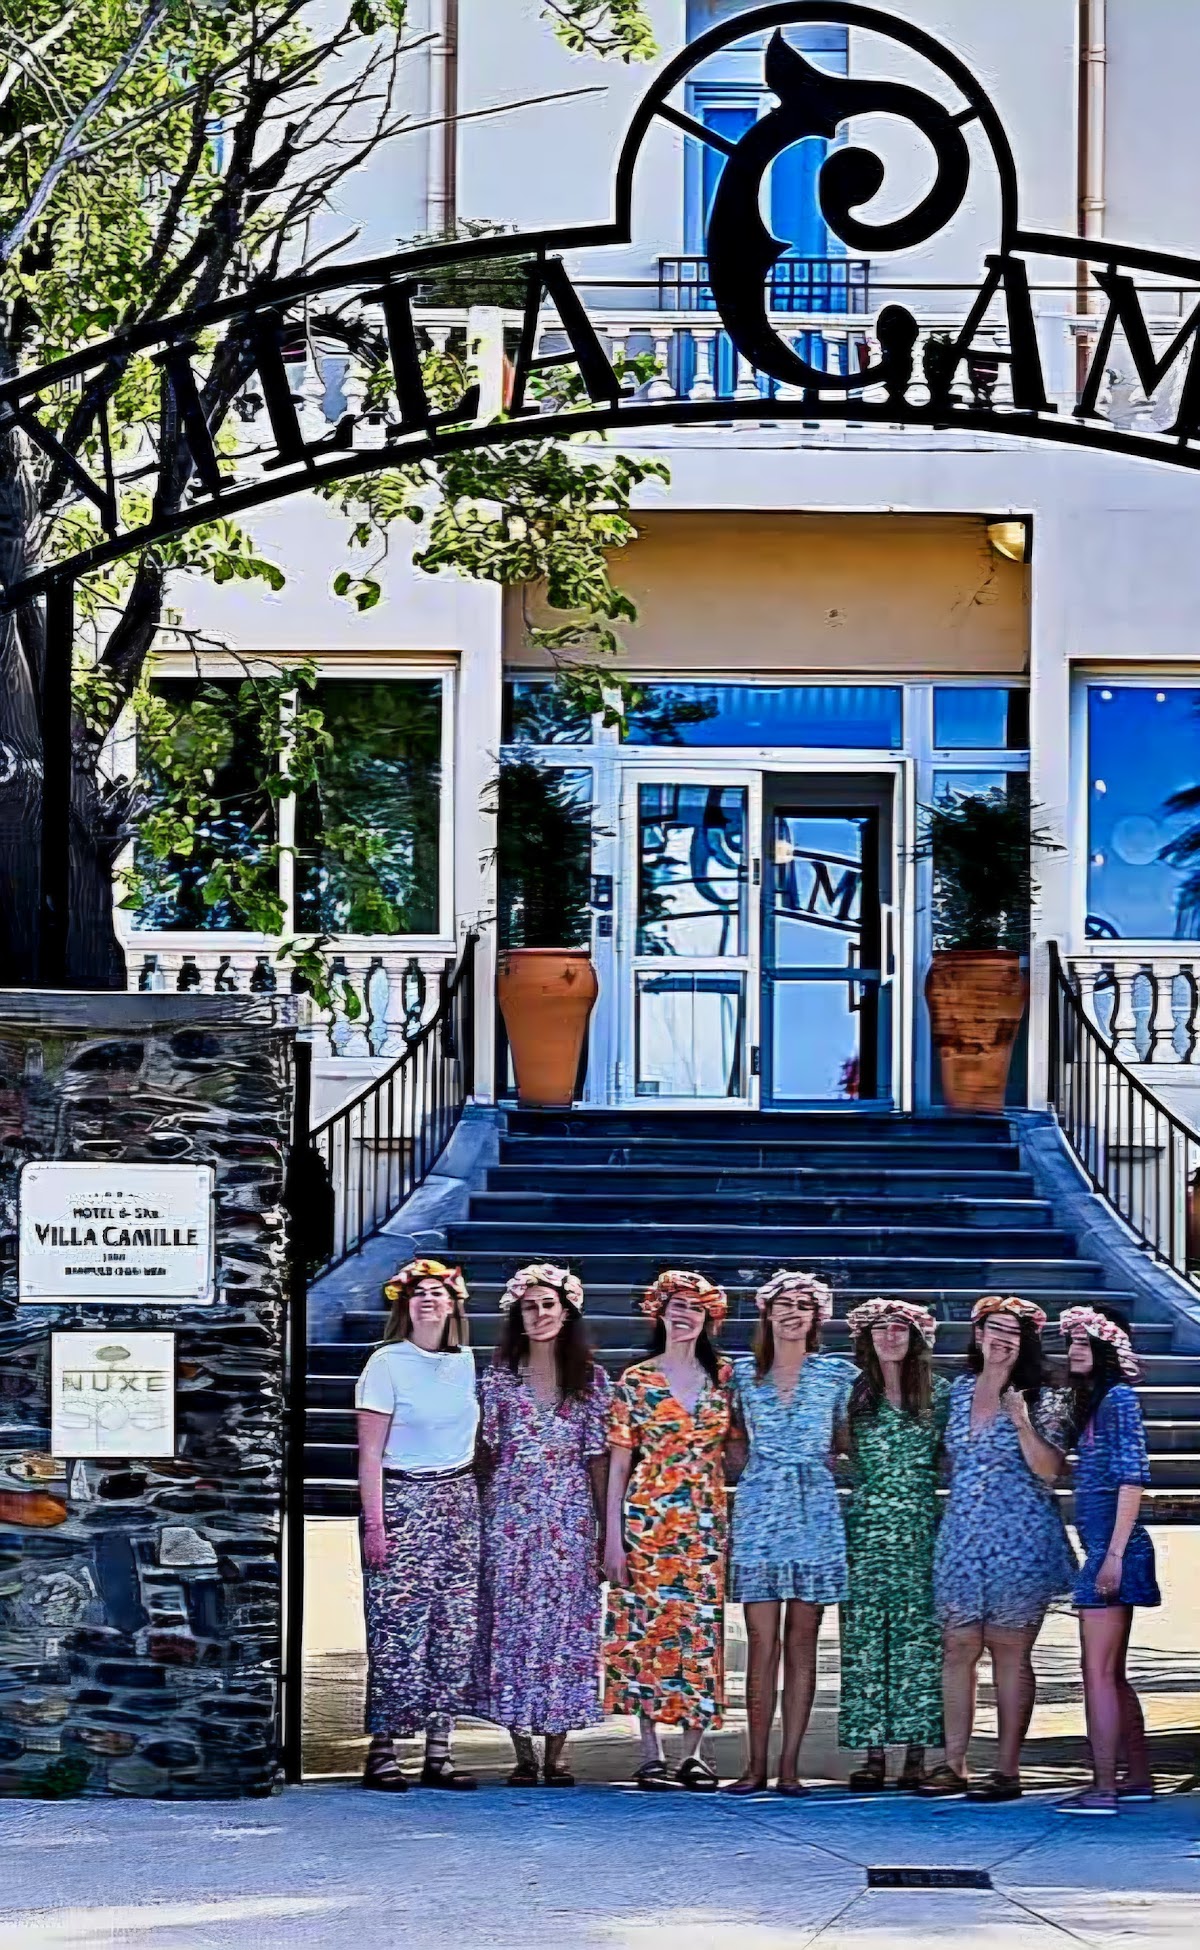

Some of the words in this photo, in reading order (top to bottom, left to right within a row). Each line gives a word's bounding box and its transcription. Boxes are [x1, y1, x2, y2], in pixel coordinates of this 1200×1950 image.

[72, 1207, 115, 1219] HOTEL
[35, 1223, 98, 1247] VILLA
[102, 1226, 199, 1248] CAMILLE
[62, 1373, 170, 1392] NUXE
